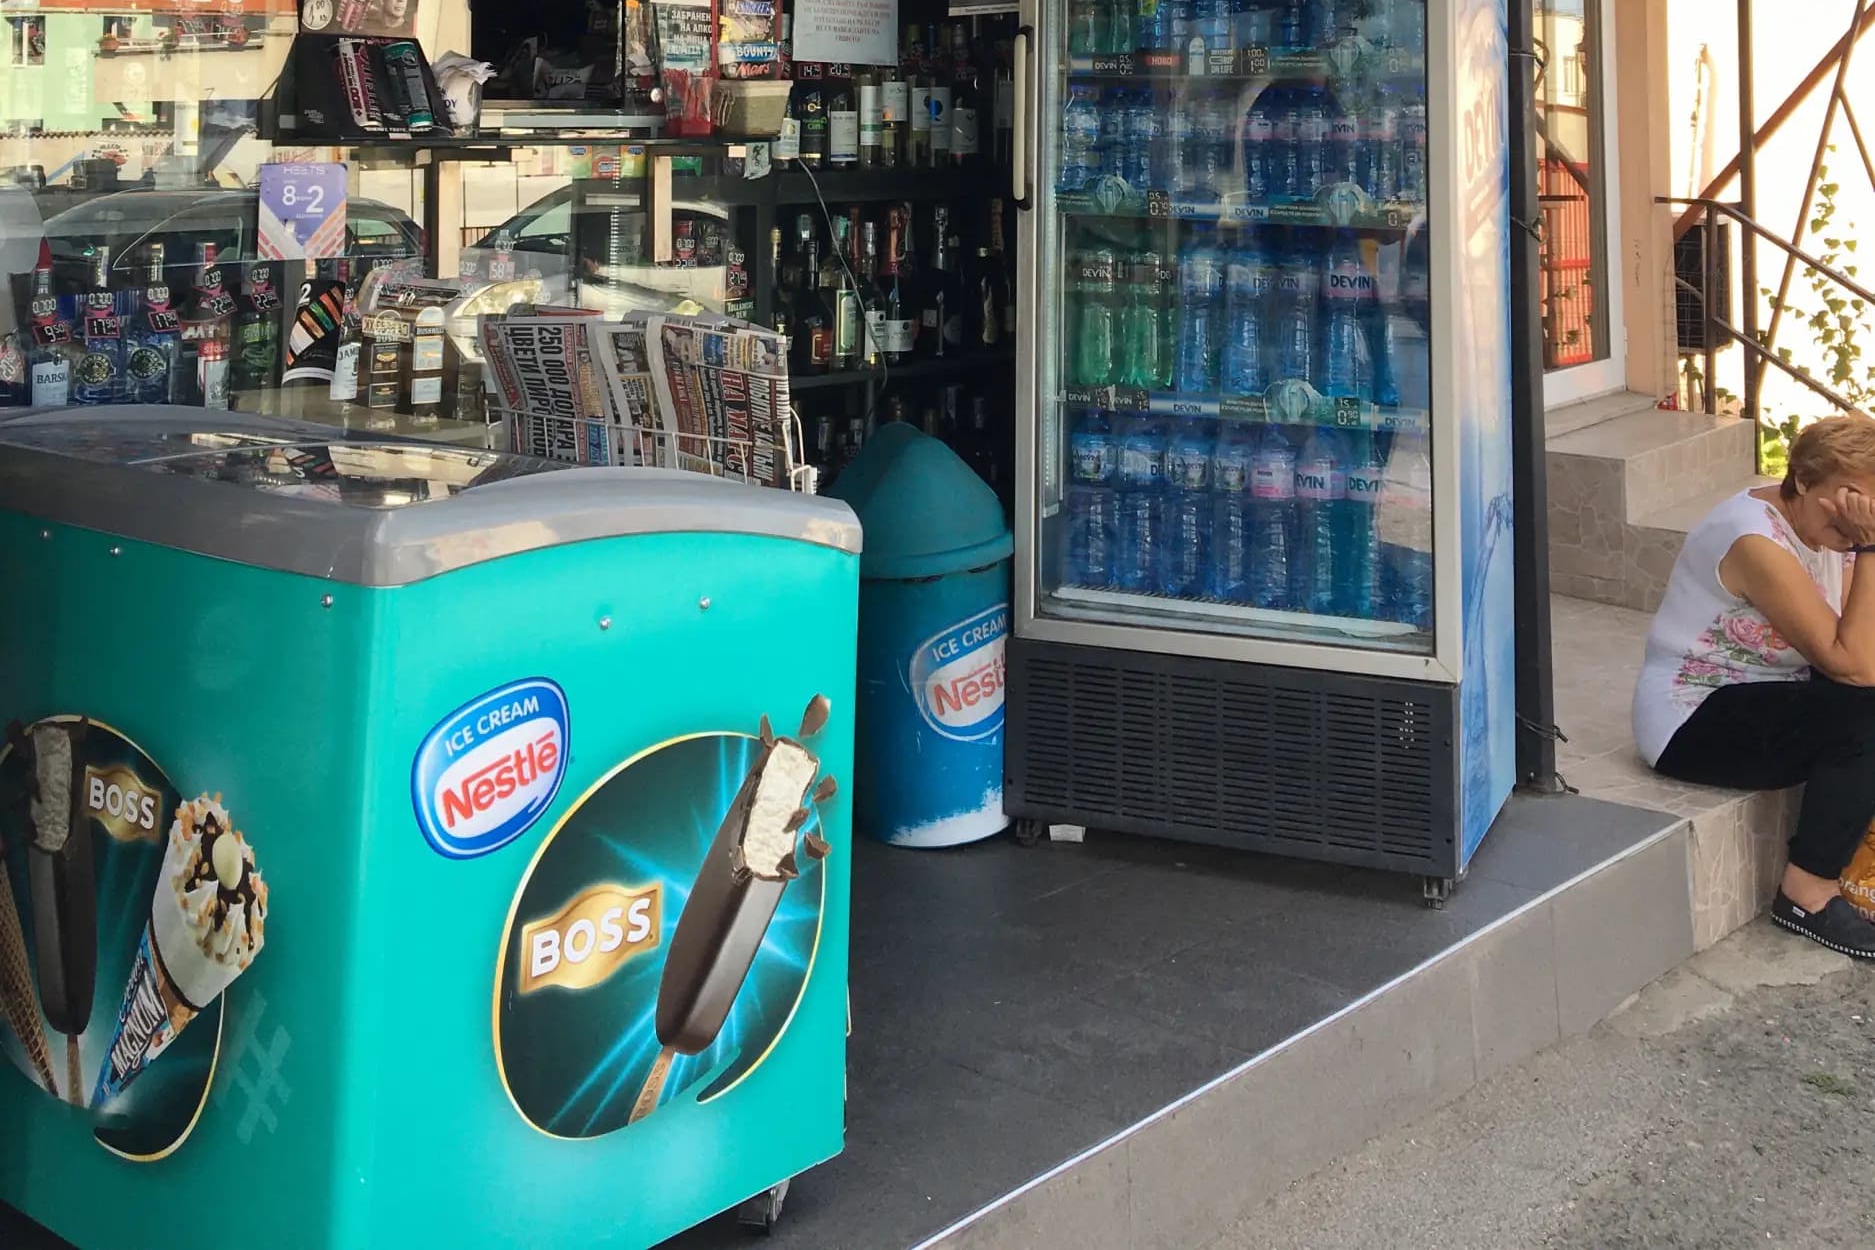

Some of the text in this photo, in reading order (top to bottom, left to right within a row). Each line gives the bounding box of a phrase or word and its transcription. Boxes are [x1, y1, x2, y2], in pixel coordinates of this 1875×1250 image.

[671, 10, 711, 20] ЗАБРАНЕН
[693, 23, 712, 33] АЛКО
[736, 44, 775, 57] BOUNTY
[1094, 61, 1118, 71] DEVIN
[282, 184, 297, 206] 8
[305, 184, 325, 214] 2
[1234, 206, 1264, 217] DEVIN
[1082, 267, 1112, 279] DEVIN
[1330, 273, 1372, 290] DEVIN
[508, 326, 541, 374] ЦВЕТИ
[537, 326, 563, 355] 250
[543, 359, 569, 385] 000
[1173, 403, 1202, 414] DEVIN
[1384, 416, 1416, 427] DEVIN
[720, 371, 750, 473] НА МАРС
[1350, 476, 1379, 493] DEVI
[931, 616, 1006, 662] ICE CREAM
[934, 652, 1006, 717] Nest
[444, 695, 540, 756] ICE CREAM
[441, 732, 560, 828] Nestlé
[88, 776, 156, 831] BOSS
[530, 897, 652, 979] BOSS
[111, 969, 165, 1079] MAGNUM
